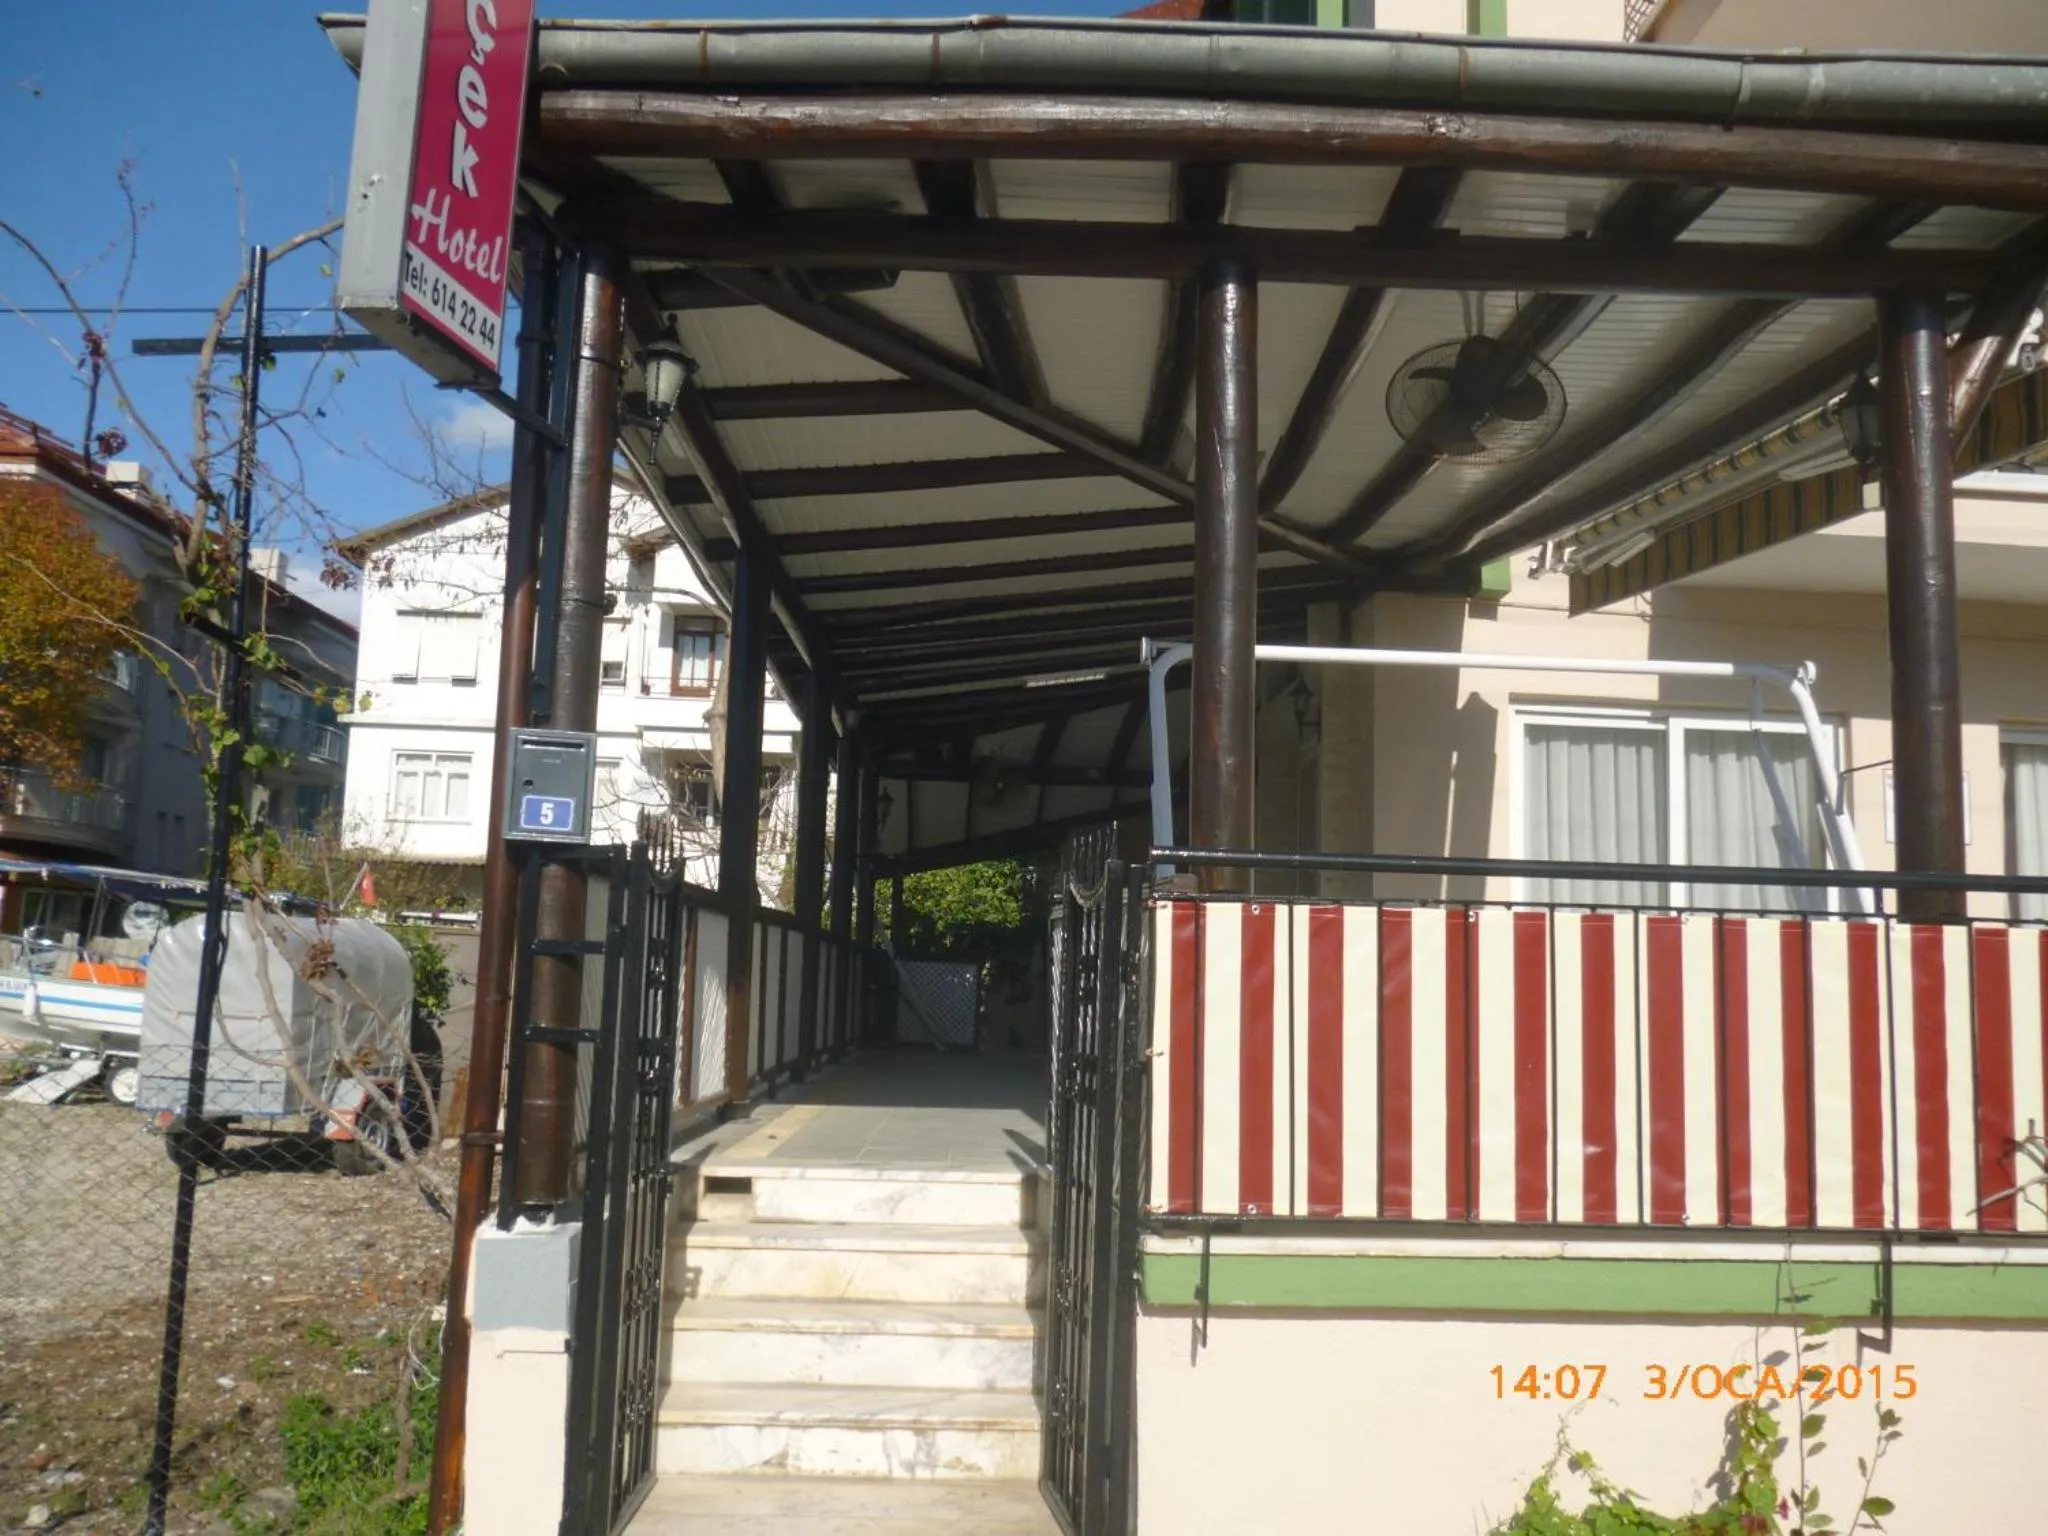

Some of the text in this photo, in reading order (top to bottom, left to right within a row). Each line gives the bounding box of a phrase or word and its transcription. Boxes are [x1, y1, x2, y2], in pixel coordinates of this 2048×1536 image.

[410, 188, 503, 285] Hotel
[404, 251, 496, 350] Tel: 614 22 44
[540, 802, 555, 825] 5
